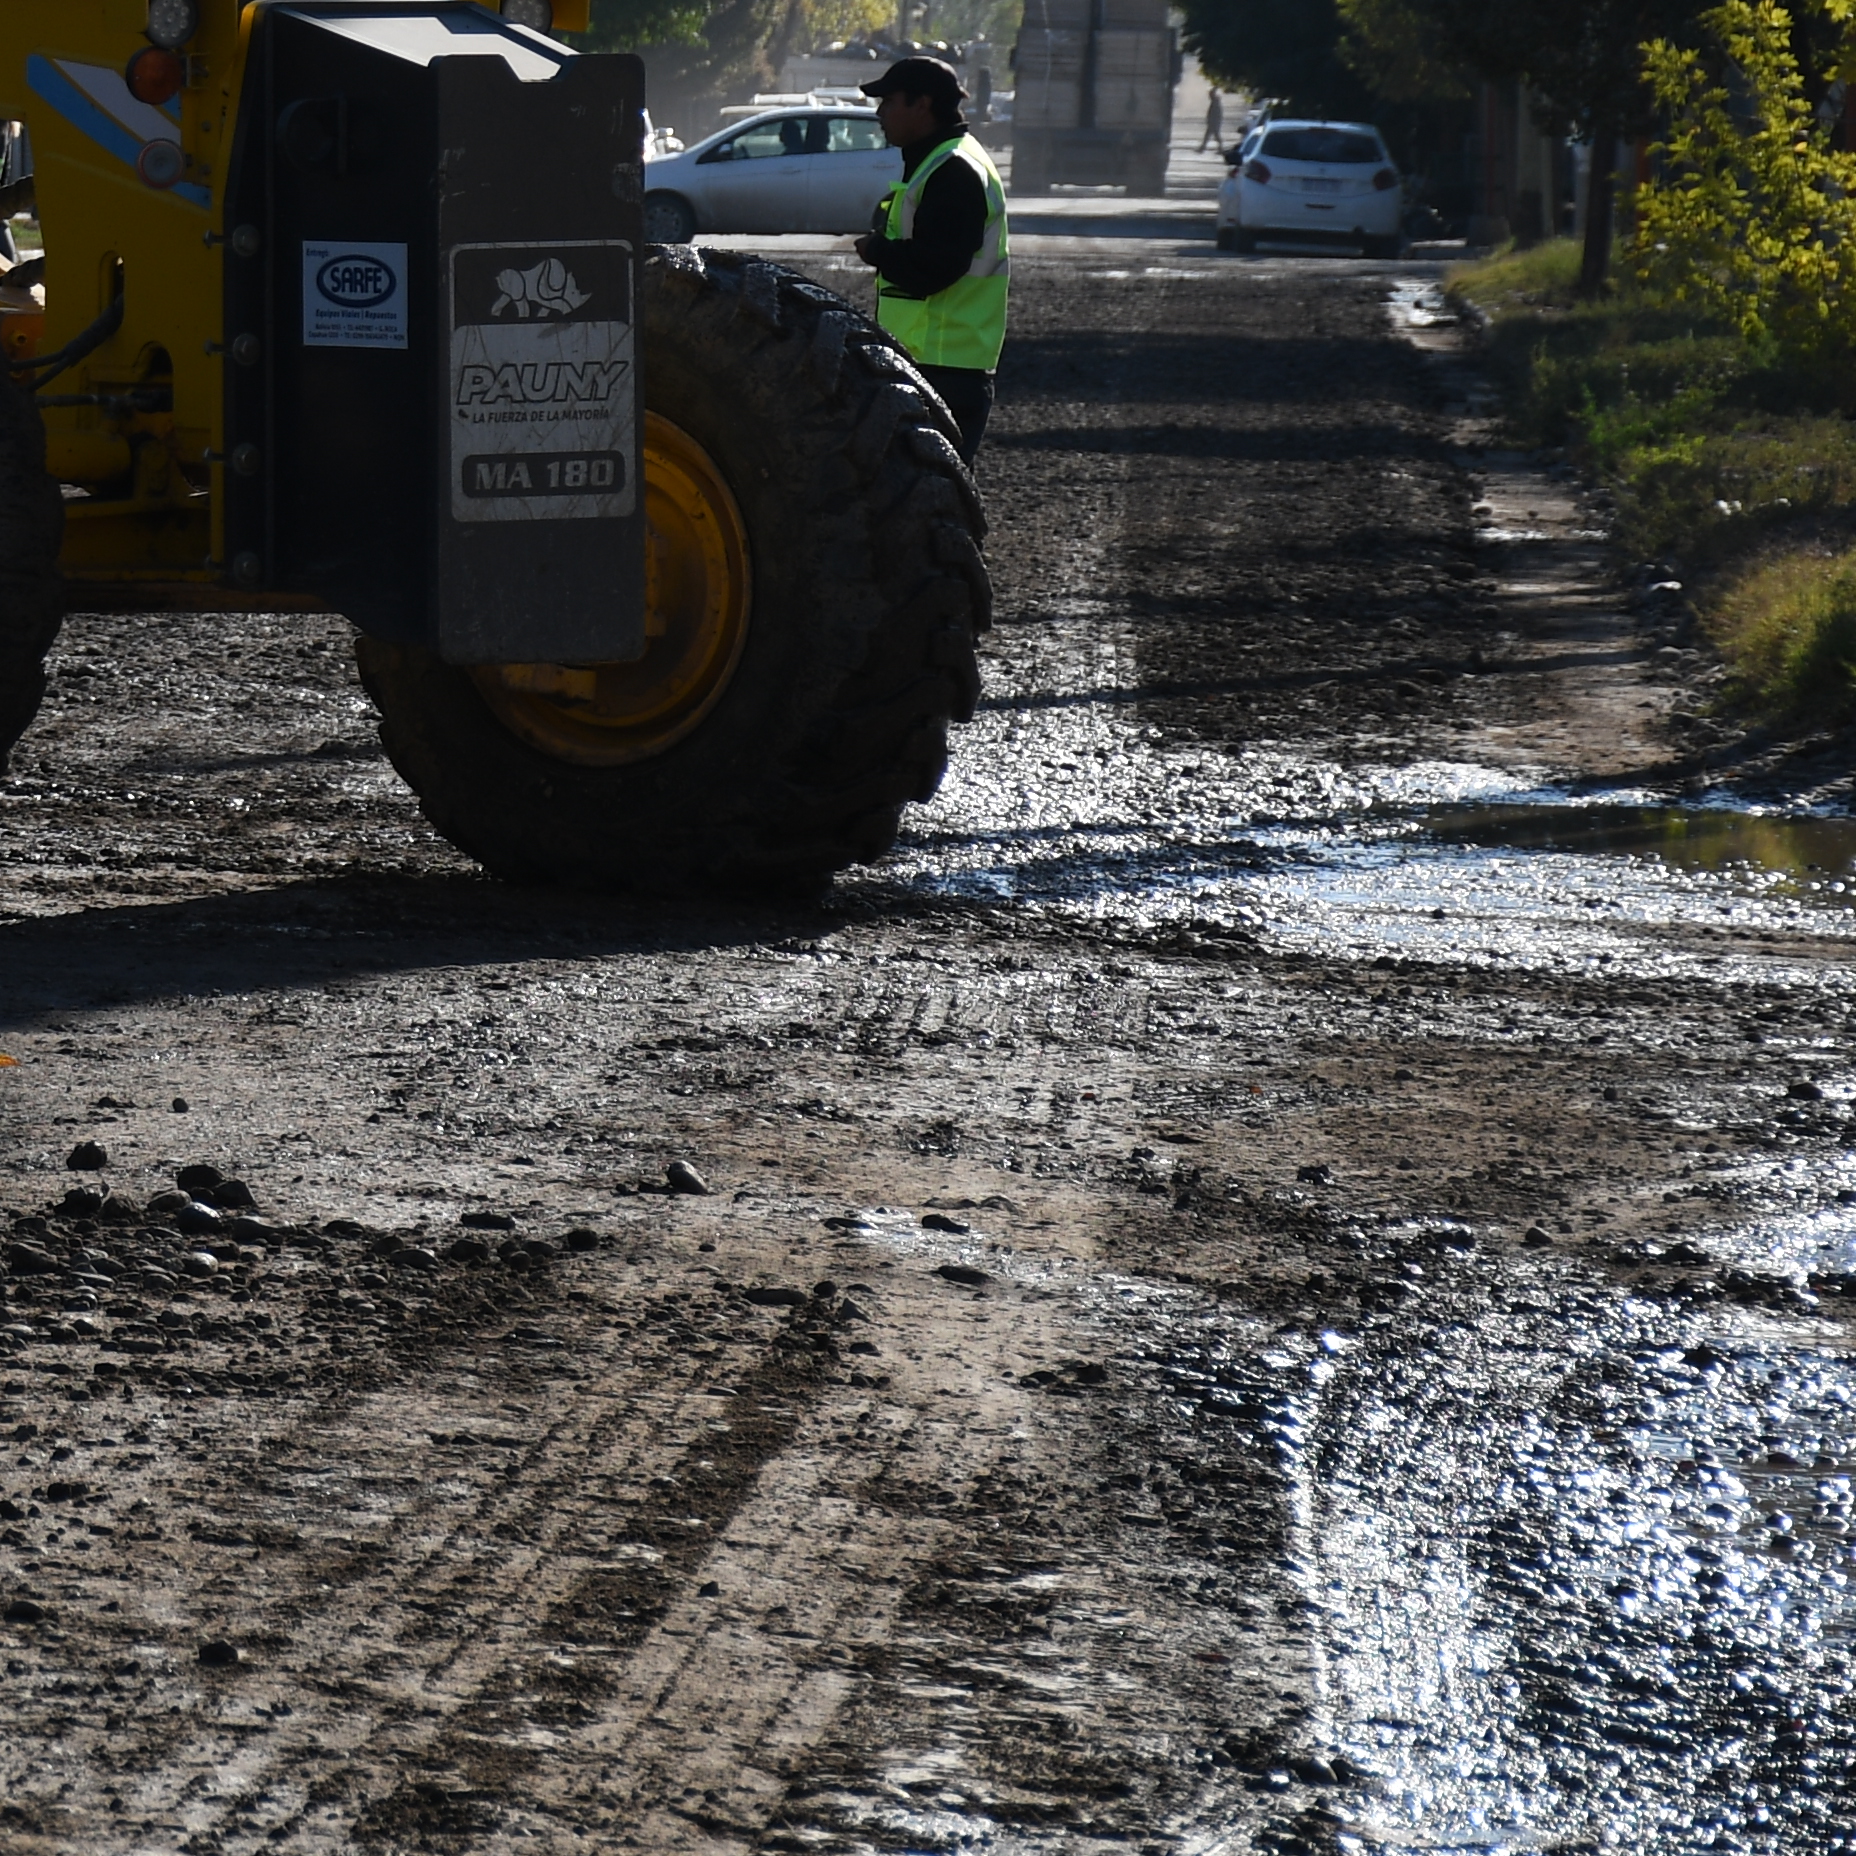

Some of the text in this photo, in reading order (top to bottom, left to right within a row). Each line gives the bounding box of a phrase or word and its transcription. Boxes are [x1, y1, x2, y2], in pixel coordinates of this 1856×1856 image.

[330, 266, 382, 294] SARFE
[456, 361, 629, 405] PAUNY
[473, 406, 610, 424] LA FUERZA DE LA MAYORÍA
[475, 459, 615, 490] MA 180
